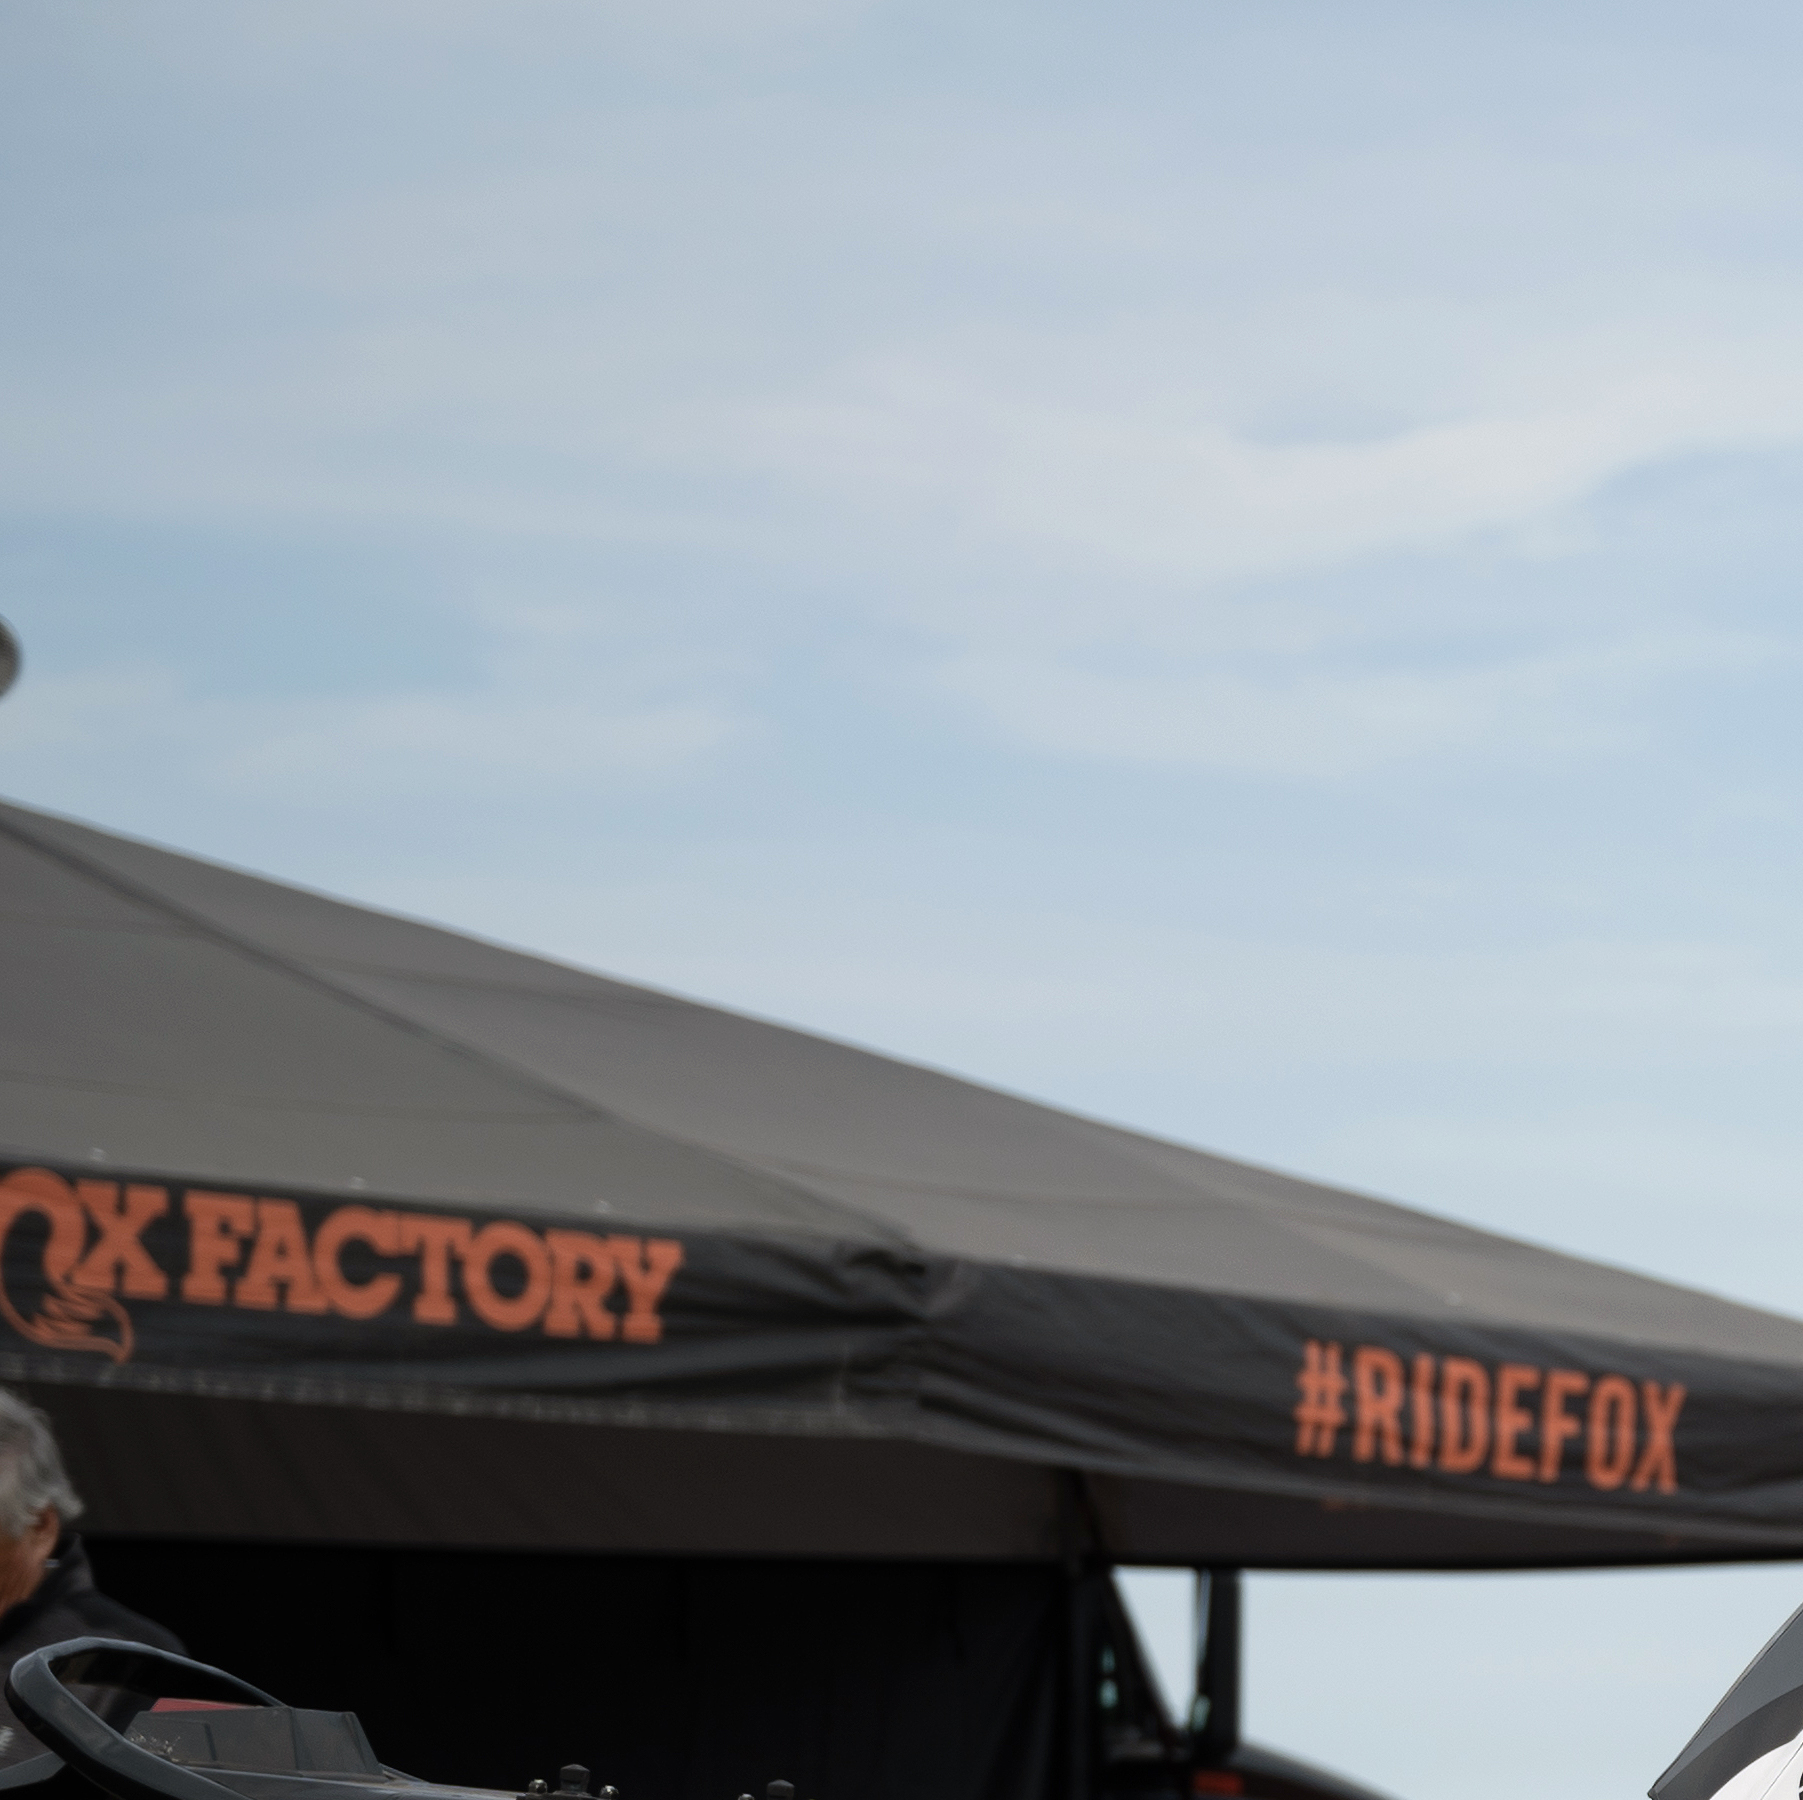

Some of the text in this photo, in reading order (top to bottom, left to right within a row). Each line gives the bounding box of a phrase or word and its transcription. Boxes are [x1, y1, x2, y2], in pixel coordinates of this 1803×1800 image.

[0, 1168, 685, 1350] OX FACTORY
[1294, 1341, 1686, 1494] #RIDEFOX
